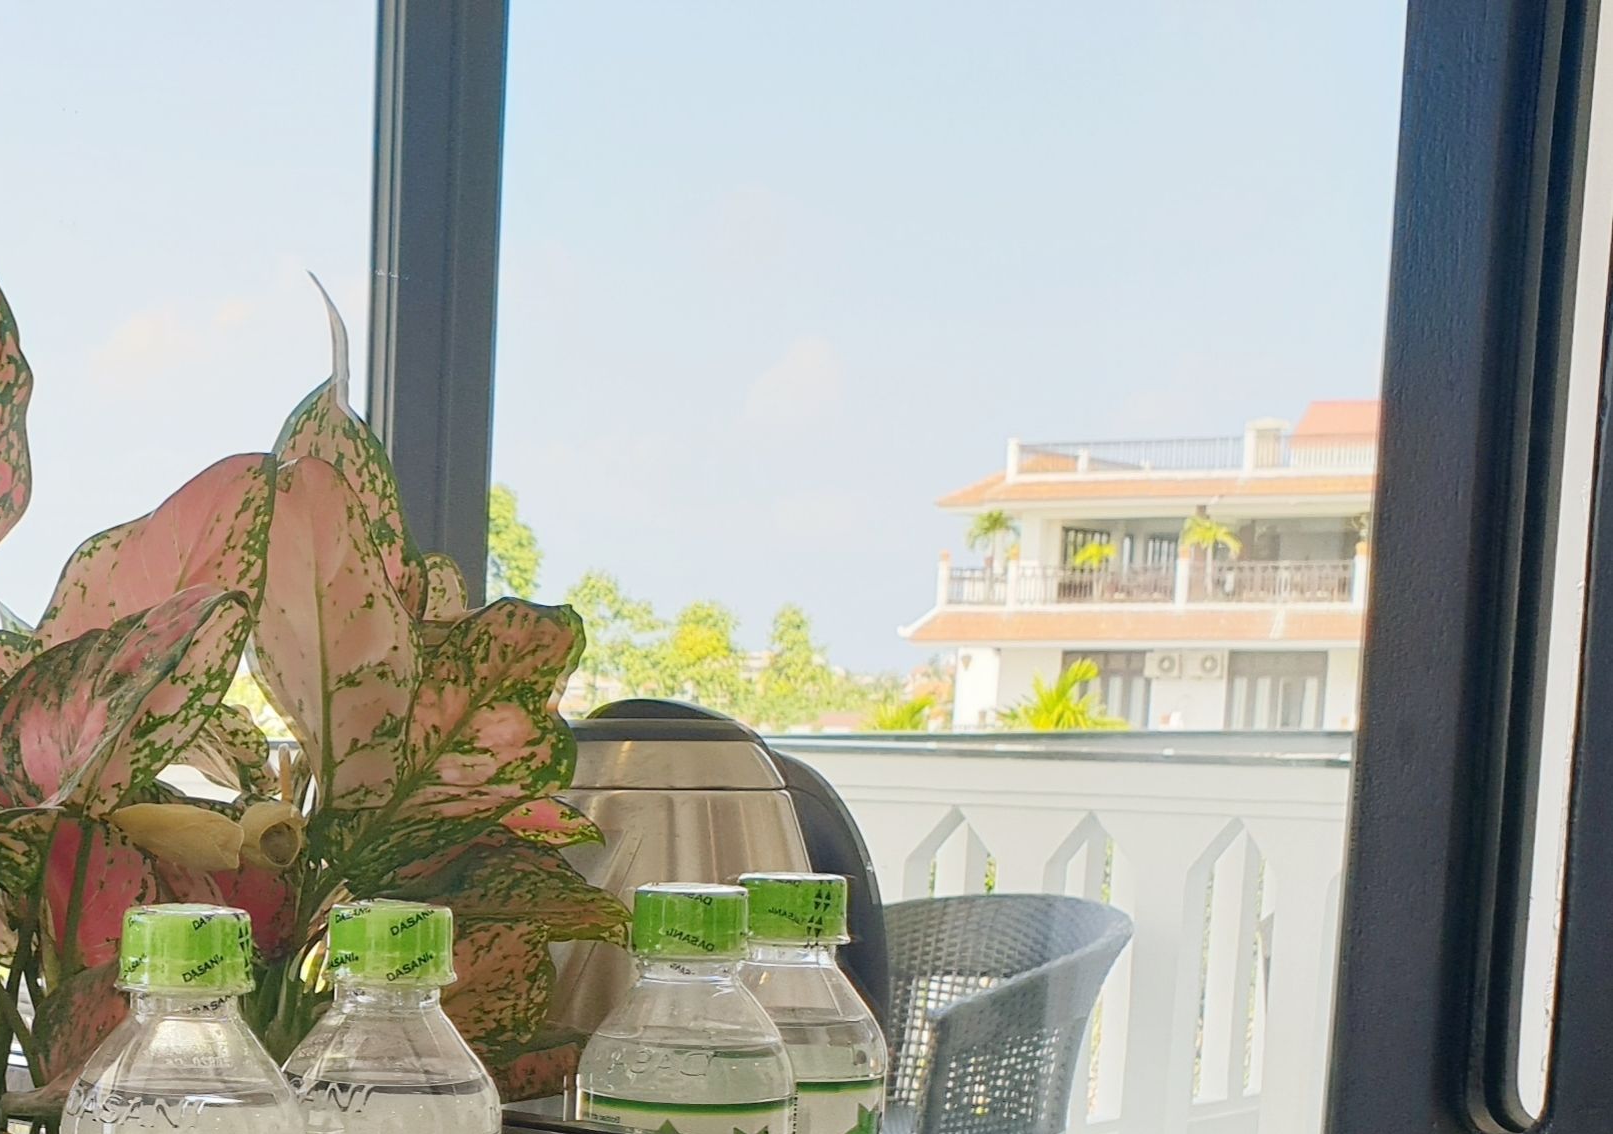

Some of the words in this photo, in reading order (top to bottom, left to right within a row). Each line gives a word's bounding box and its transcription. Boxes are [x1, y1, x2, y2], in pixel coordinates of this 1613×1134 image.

[390, 909, 434, 936] DASANI
[182, 954, 224, 983] DASANI
[386, 952, 434, 981] DASANI
